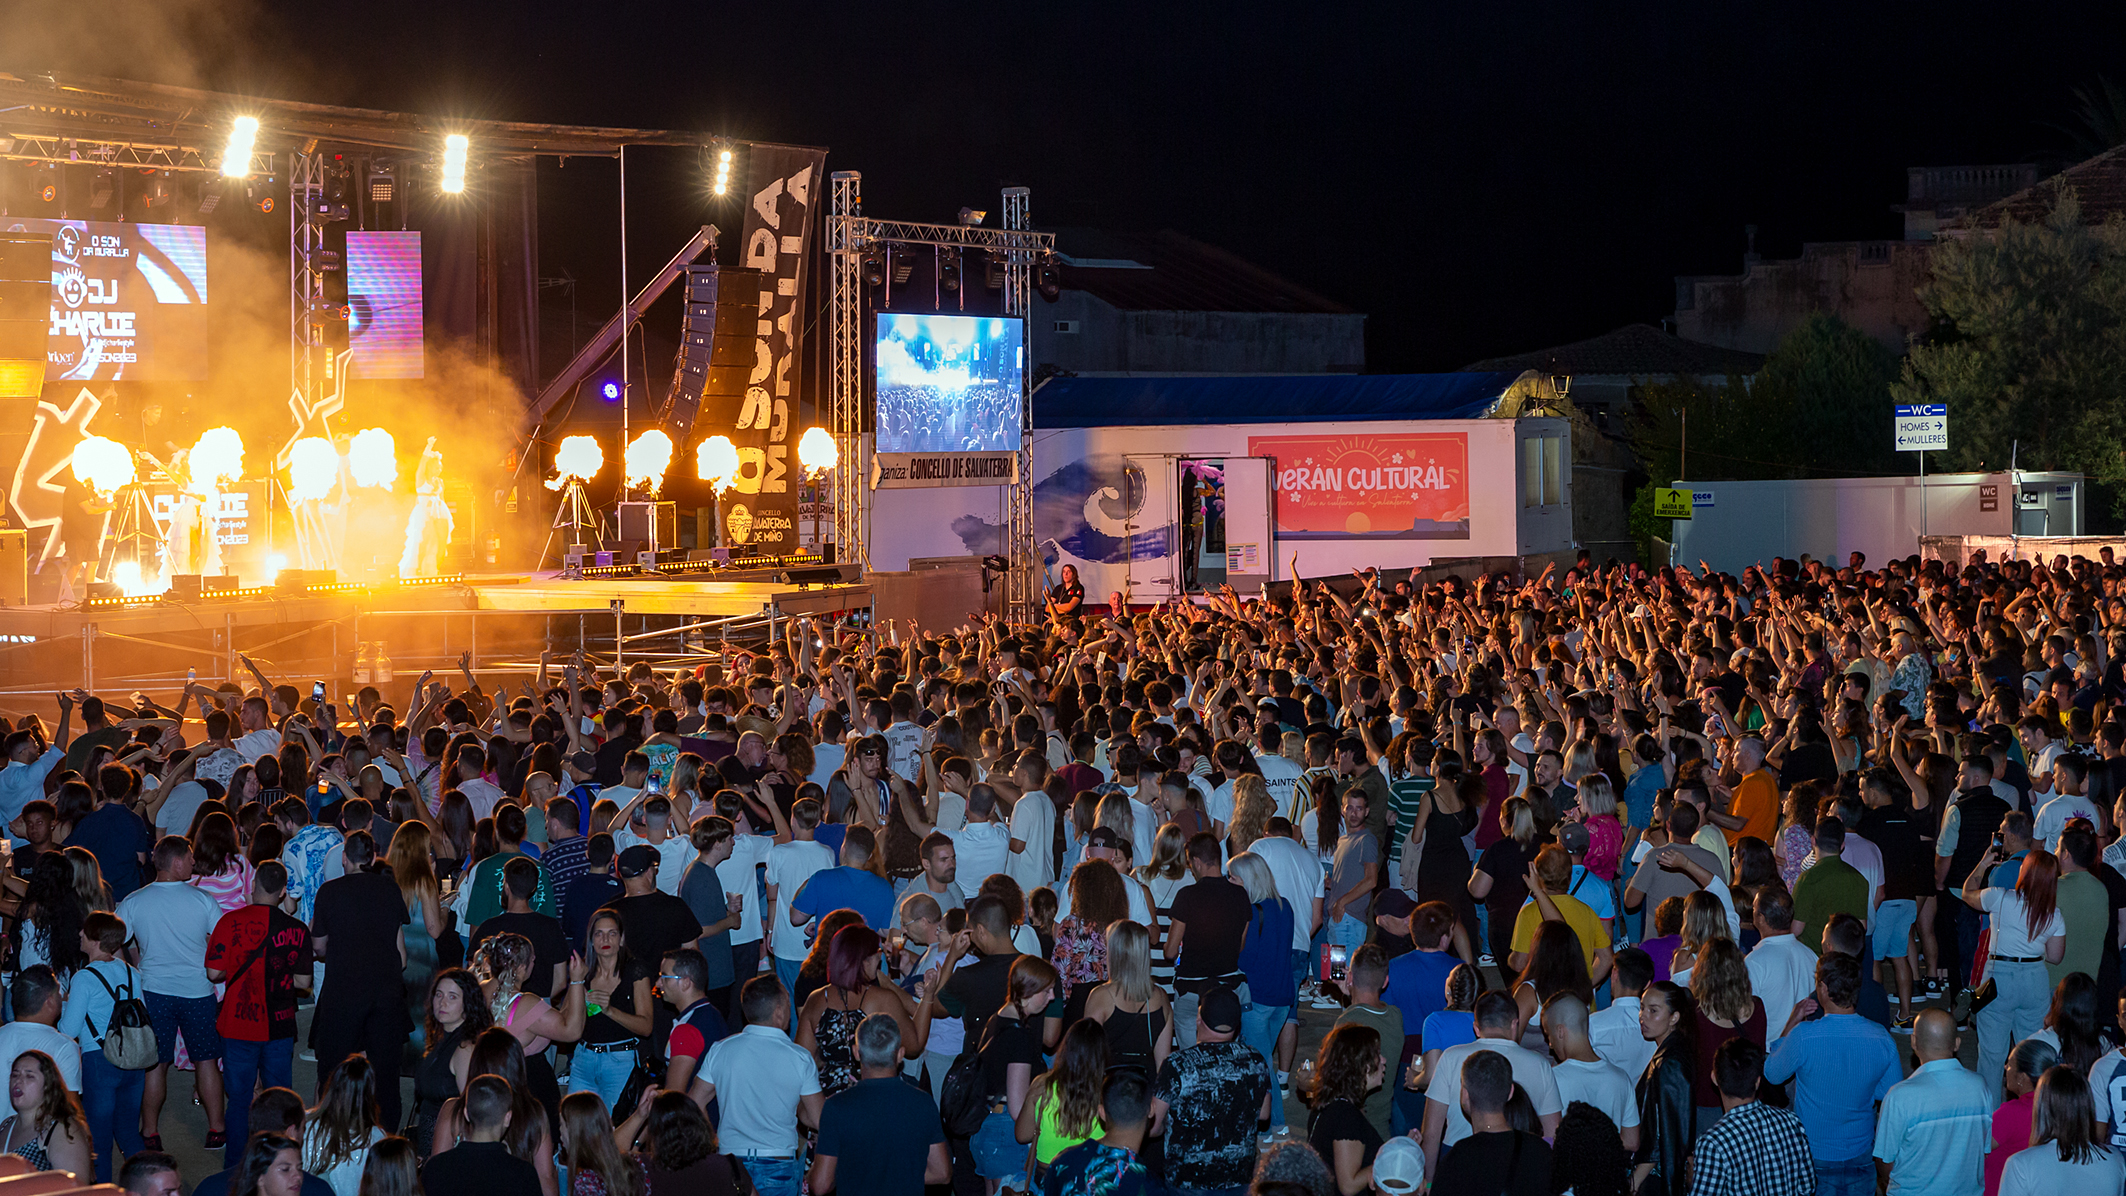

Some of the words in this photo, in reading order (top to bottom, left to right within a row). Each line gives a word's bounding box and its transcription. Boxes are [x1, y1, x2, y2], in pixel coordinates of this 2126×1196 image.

[746, 177, 784, 273] DA
[91, 235, 99, 247] O
[101, 236, 120, 247] SON
[82, 247, 93, 256] DA
[94, 248, 129, 257] MURALLA
[87, 278, 118, 304] DJ
[1911, 405, 1931, 416] WC
[1900, 422, 1930, 431] HOMES
[1907, 434, 1947, 444] MULLERES
[877, 463, 908, 485] ganiza:
[910, 458, 950, 480] CONCELLO
[952, 458, 964, 478] DE
[965, 457, 1013, 478] SALVATERRA
[1347, 466, 1450, 491] CULTURAL
[1982, 488, 1996, 496] WC
[1661, 502, 1677, 510] SAÍDA
[754, 531, 763, 542] DE
[1265, 778, 1297, 787] SAINTS
[272, 927, 306, 948] LOYALTY
